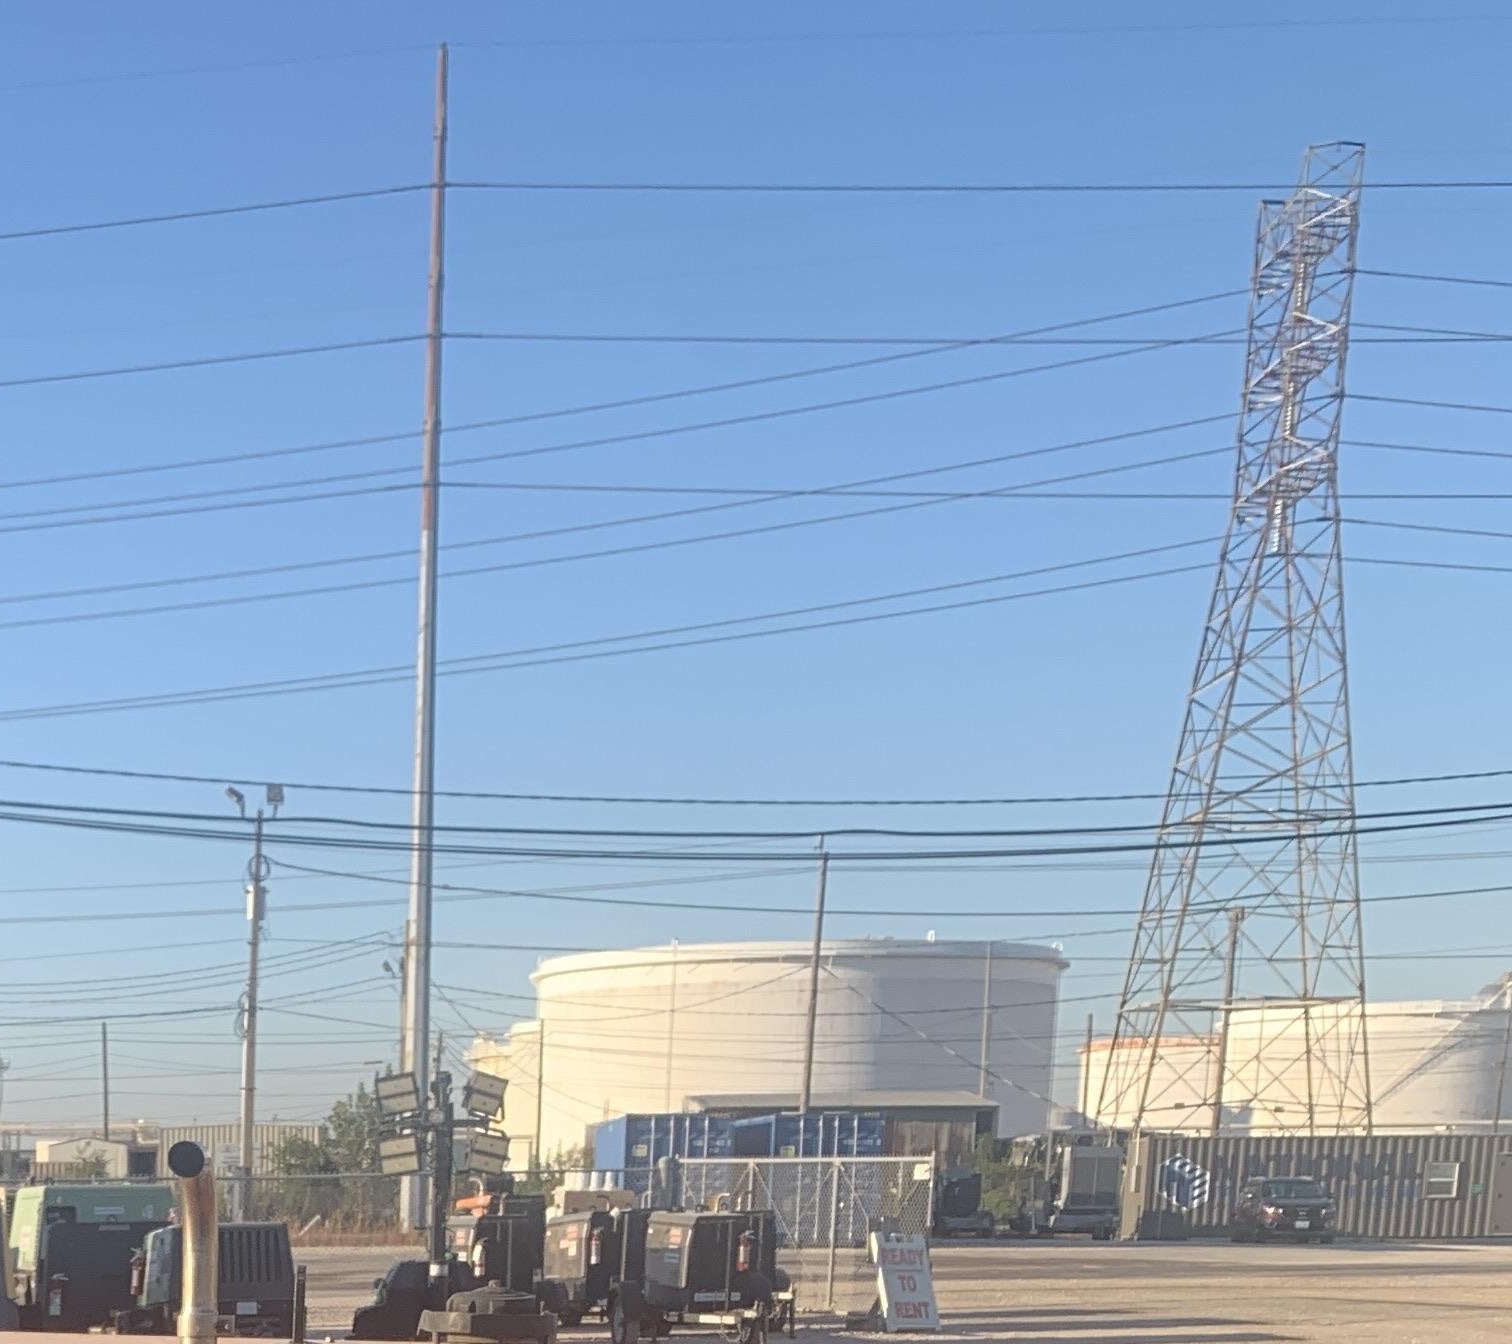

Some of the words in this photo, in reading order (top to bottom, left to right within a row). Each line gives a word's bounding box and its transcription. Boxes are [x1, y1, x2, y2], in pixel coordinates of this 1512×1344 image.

[881, 1248, 924, 1265] READY
[897, 1273, 918, 1293] TO
[894, 1302, 930, 1319] RENT
